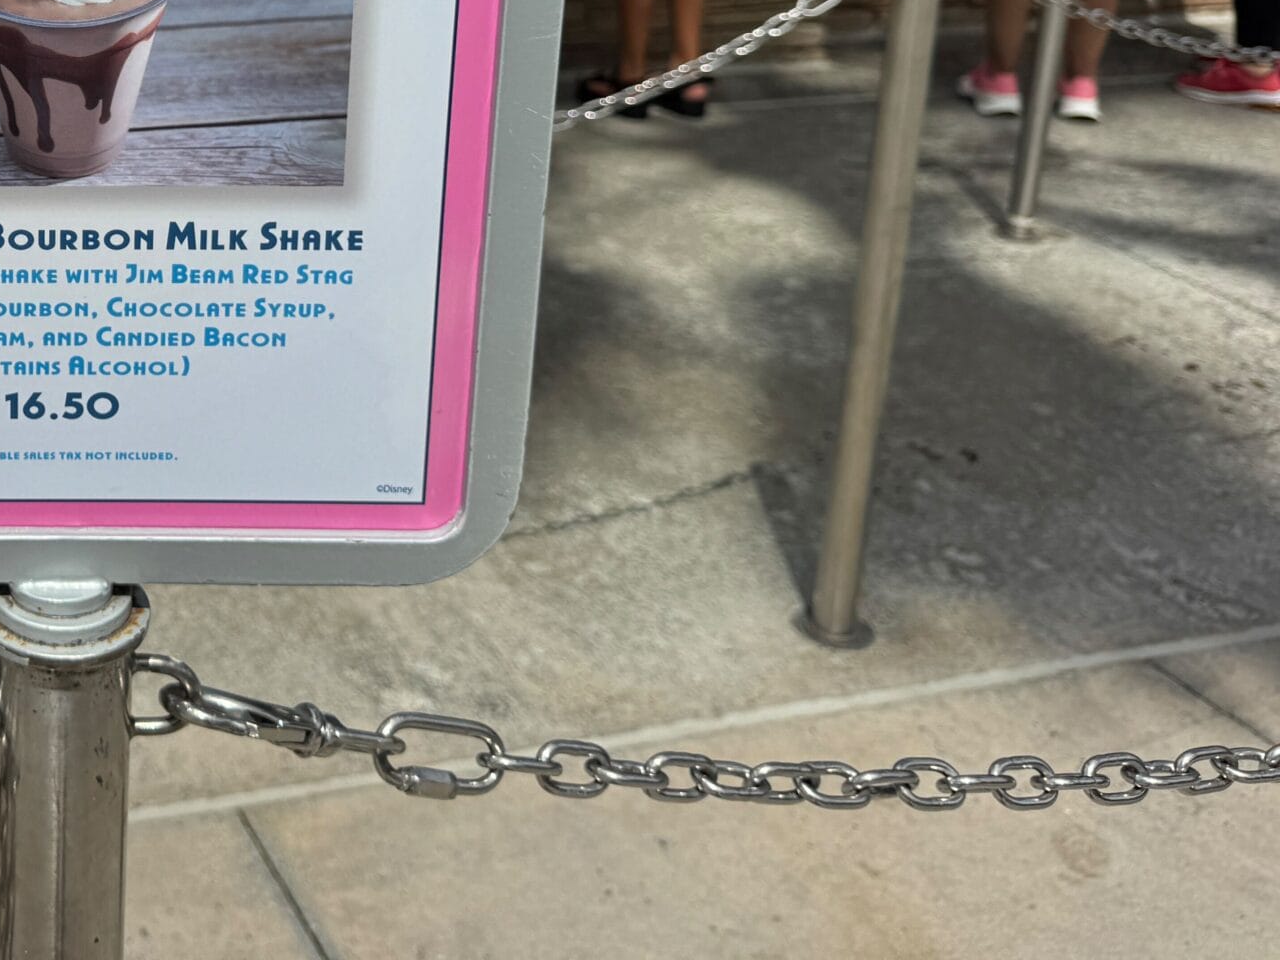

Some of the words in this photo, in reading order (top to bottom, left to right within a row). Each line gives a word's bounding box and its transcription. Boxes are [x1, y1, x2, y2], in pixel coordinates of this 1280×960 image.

[166, 221, 248, 251] MILK
[260, 221, 364, 251] SHAKE
[5, 392, 120, 421] 16.50
